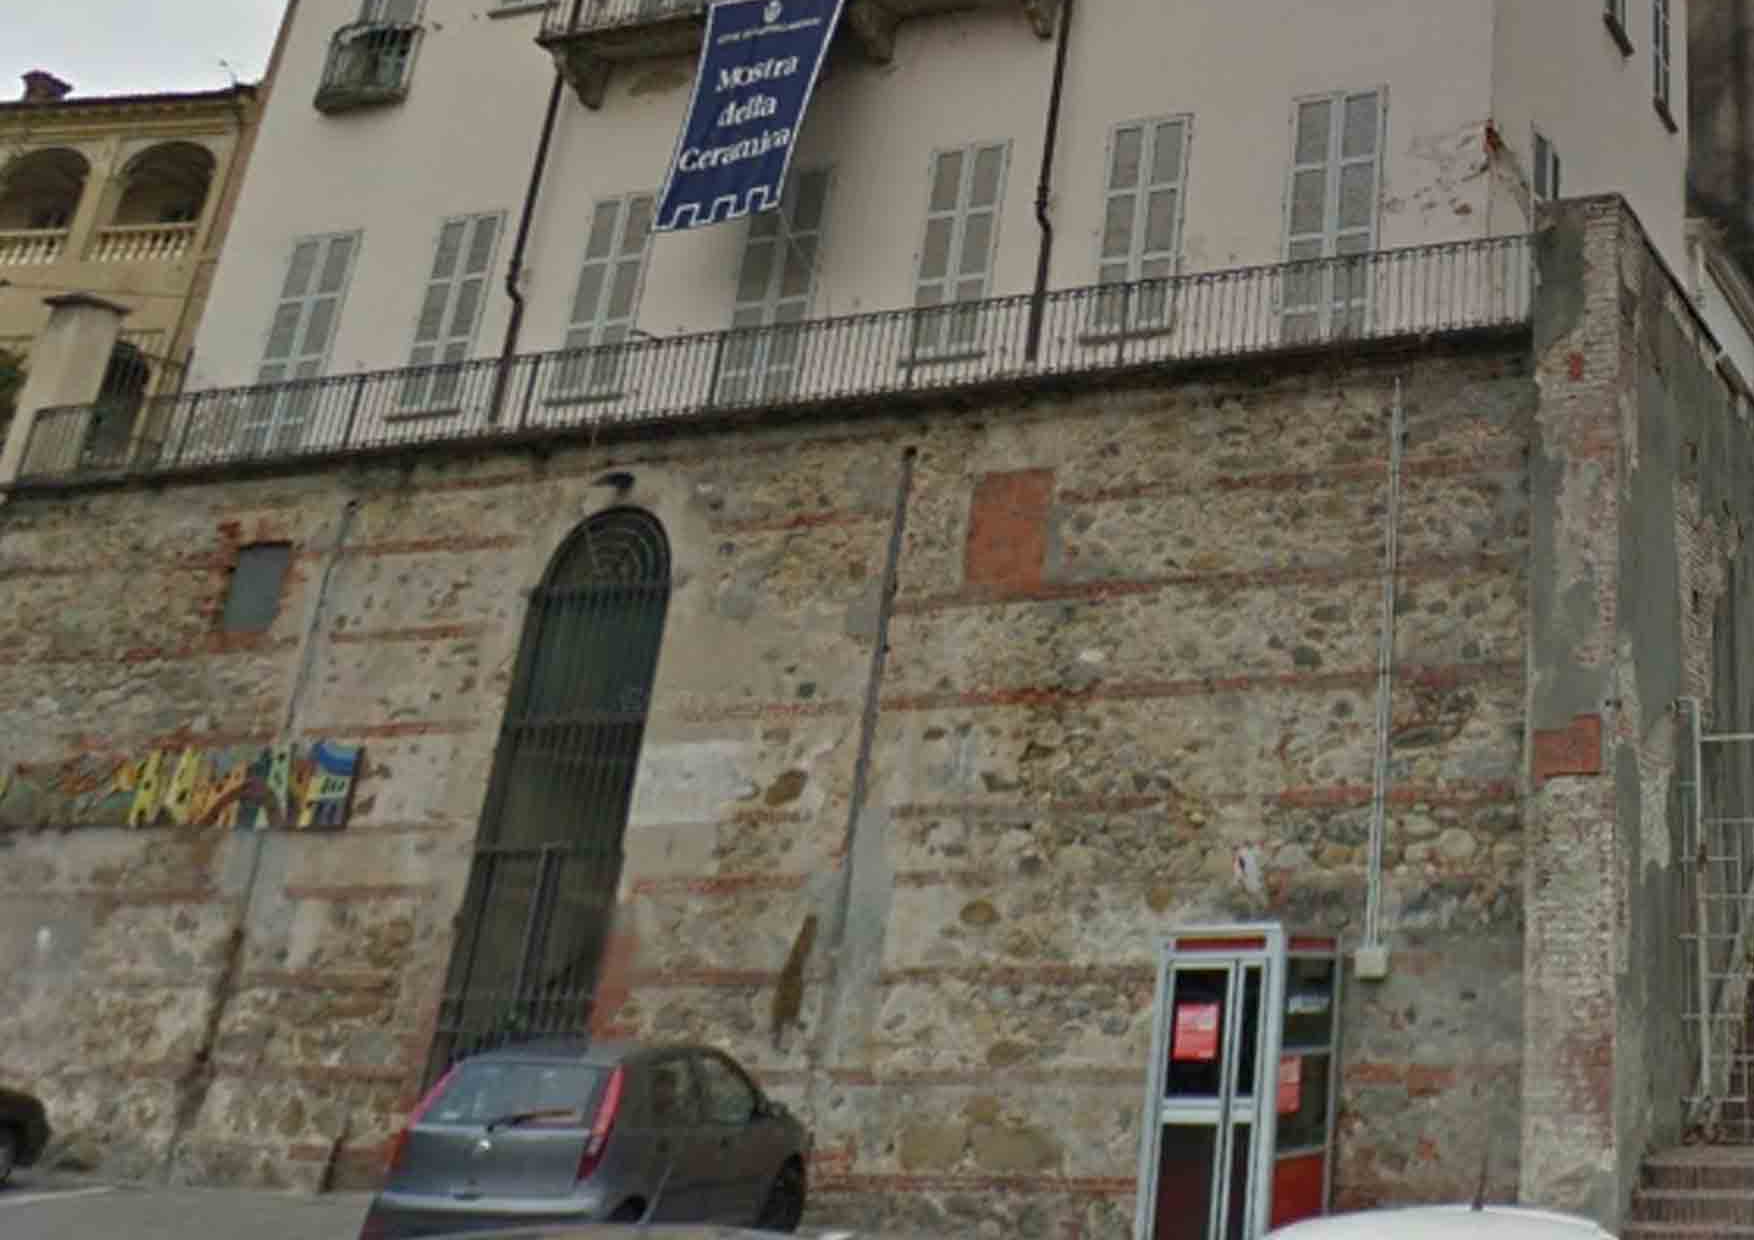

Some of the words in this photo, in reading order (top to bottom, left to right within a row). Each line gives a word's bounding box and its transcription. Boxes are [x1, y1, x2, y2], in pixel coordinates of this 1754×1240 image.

[715, 56, 799, 92] Mostra
[717, 94, 777, 127] della
[679, 128, 790, 172] Ceramica
